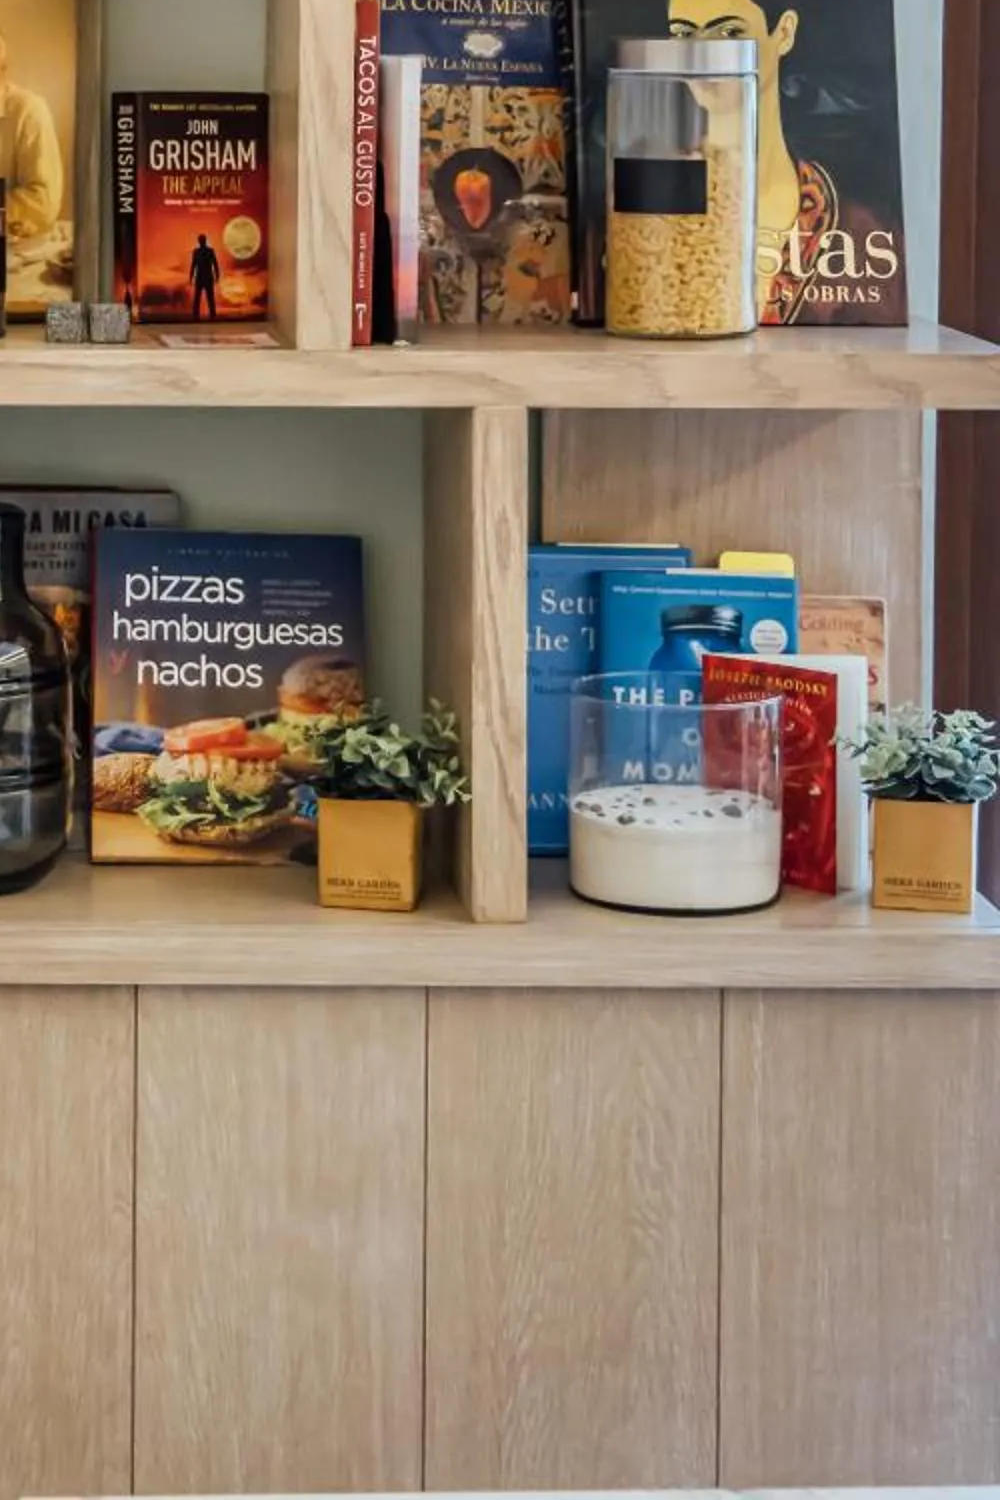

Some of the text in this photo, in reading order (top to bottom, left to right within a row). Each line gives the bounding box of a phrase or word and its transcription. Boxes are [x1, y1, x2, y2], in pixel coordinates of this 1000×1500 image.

[186, 119, 219, 135] JOHN
[355, 36, 377, 207] TACOS AL GUSTO
[117, 117, 135, 214] GRISHAM
[150, 139, 257, 171] GRISHAM
[162, 175, 244, 194] THE APPEAL
[803, 285, 881, 303] OBRAS
[52, 510, 80, 533] MI
[125, 565, 245, 608] pizzas
[113, 610, 344, 649] hamburguesas
[137, 654, 263, 688] nachos
[613, 686, 665, 707] THE
